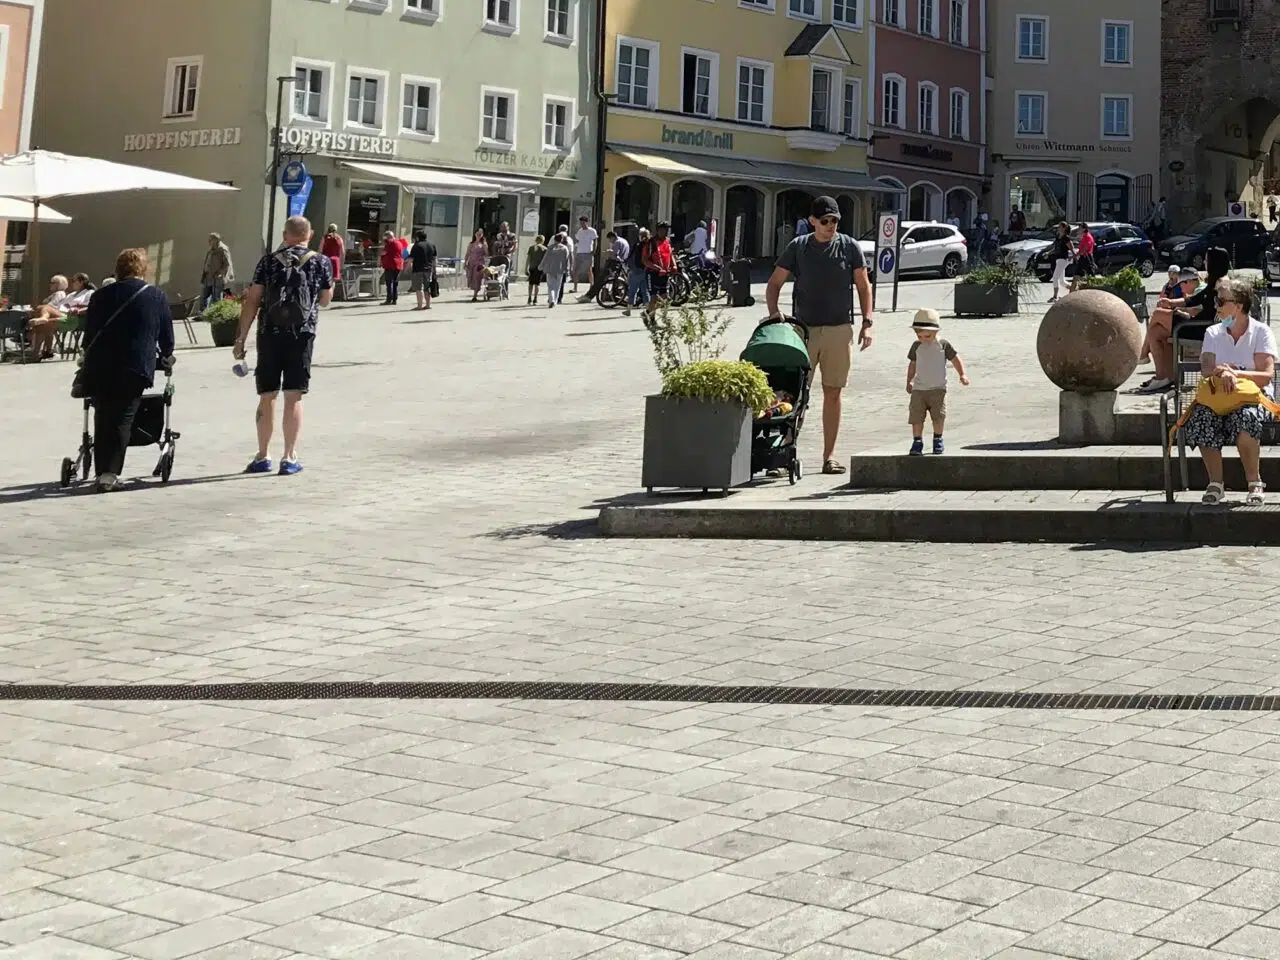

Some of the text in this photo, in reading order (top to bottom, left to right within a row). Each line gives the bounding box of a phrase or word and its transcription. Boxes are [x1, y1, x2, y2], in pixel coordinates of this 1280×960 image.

[123, 127, 241, 152] HOFPFISTEREI
[278, 126, 398, 156] HOFPFISTEREI
[661, 124, 734, 150] brand&nill
[1043, 141, 1095, 152] Wittmann
[474, 147, 518, 166] TÖLZER
[885, 222, 894, 233] 30
